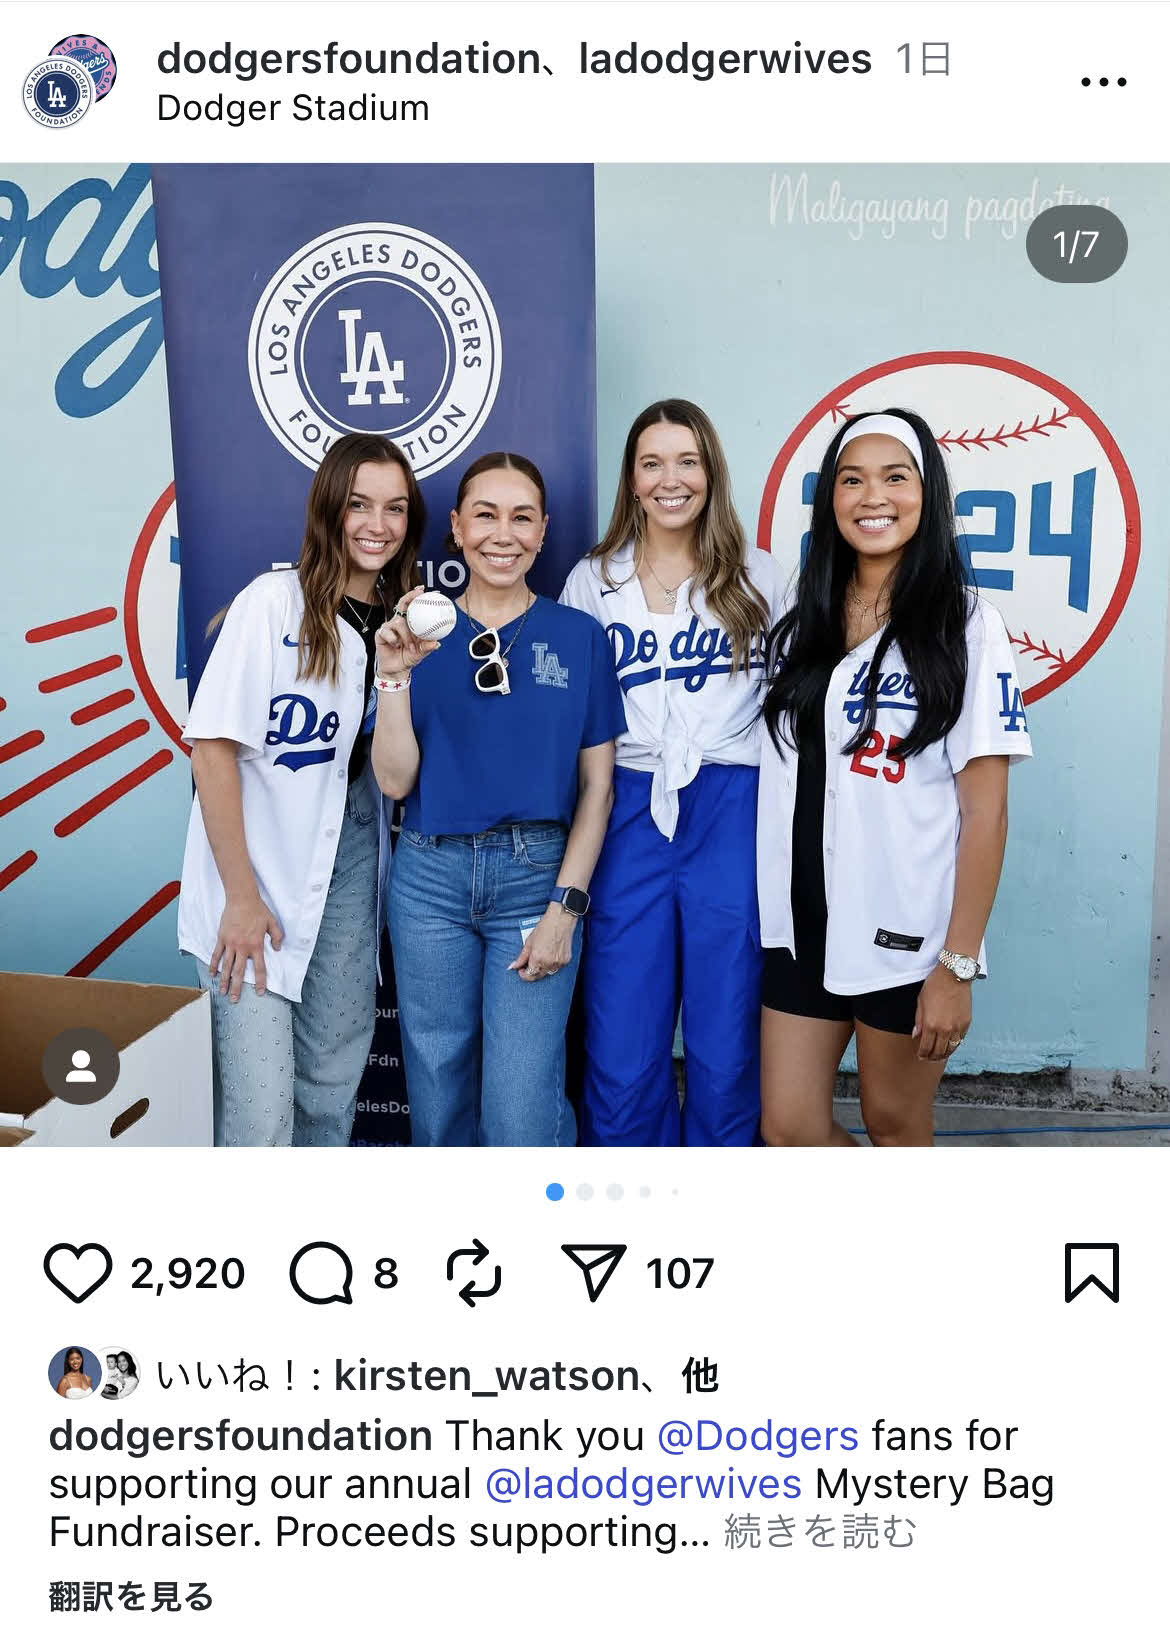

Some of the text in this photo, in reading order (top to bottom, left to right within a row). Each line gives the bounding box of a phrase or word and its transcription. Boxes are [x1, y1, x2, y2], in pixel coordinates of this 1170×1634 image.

[768, 172, 950, 240] Maligayang
[268, 243, 482, 376] LOS ANGELES DODGERS
[337, 308, 405, 406] LA
[288, 403, 467, 461] FOTION
[531, 642, 569, 688] LA
[265, 693, 340, 746] Do
[850, 730, 906, 784] 25
